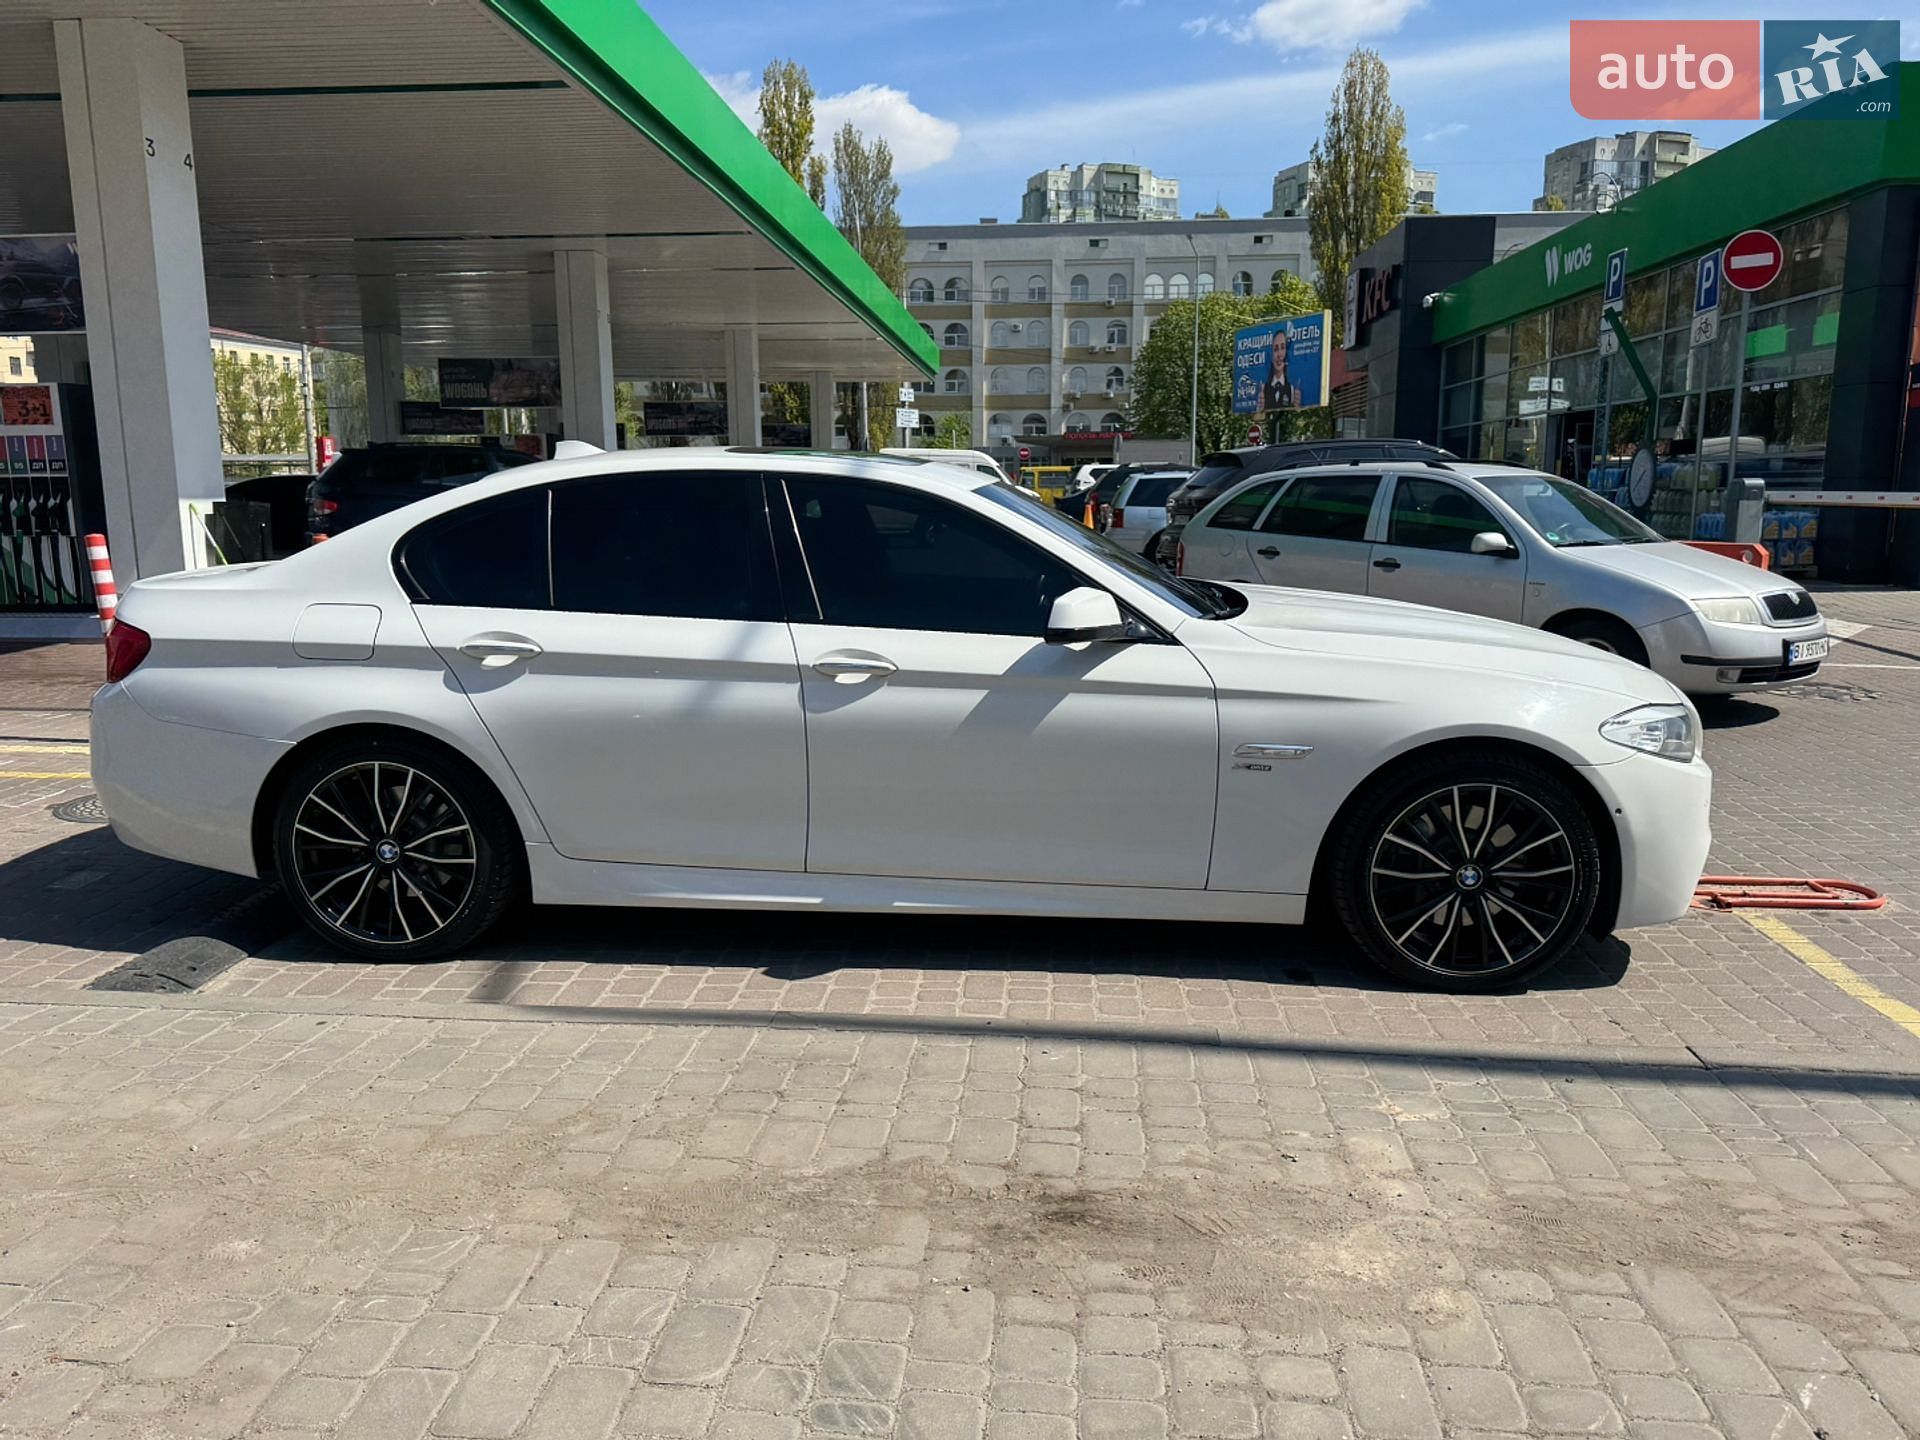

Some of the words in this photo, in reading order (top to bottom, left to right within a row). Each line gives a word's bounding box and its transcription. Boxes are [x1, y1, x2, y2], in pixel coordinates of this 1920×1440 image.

[145, 137, 155, 157] 3
[184, 153, 193, 171] 4
[1564, 243, 1592, 275] WOG
[1610, 258, 1620, 296] P
[1701, 260, 1714, 306] P
[1361, 270, 1392, 324] KFC
[1237, 331, 1273, 351] КРАЩИЙ
[1237, 351, 1265, 368] ОДЕСИ
